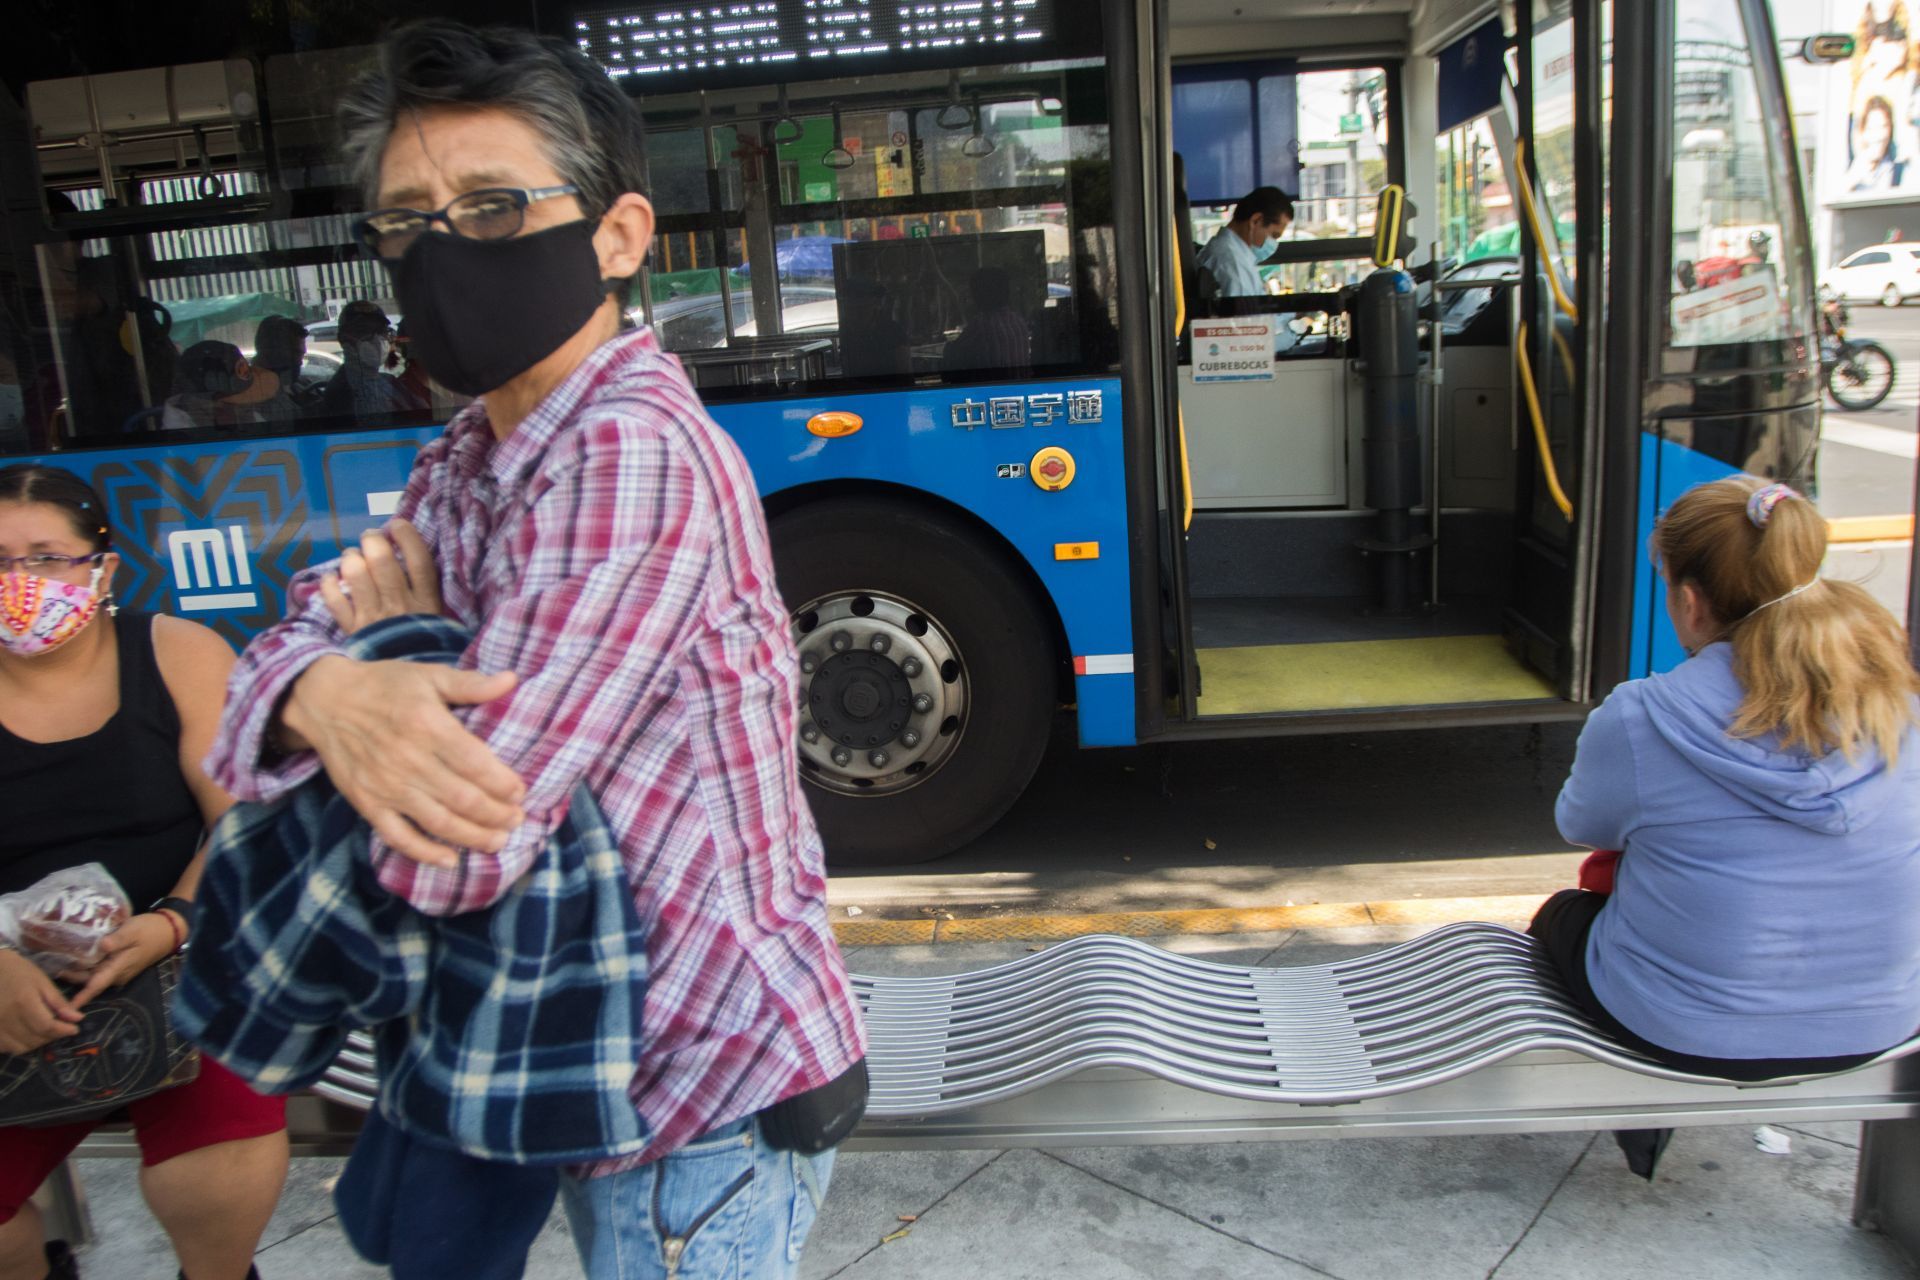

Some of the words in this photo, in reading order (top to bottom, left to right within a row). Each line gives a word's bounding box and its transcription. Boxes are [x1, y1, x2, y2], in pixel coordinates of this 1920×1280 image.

[1199, 360, 1269, 372] CUBREBOCAS
[951, 389, 1103, 431] 中国宇通
